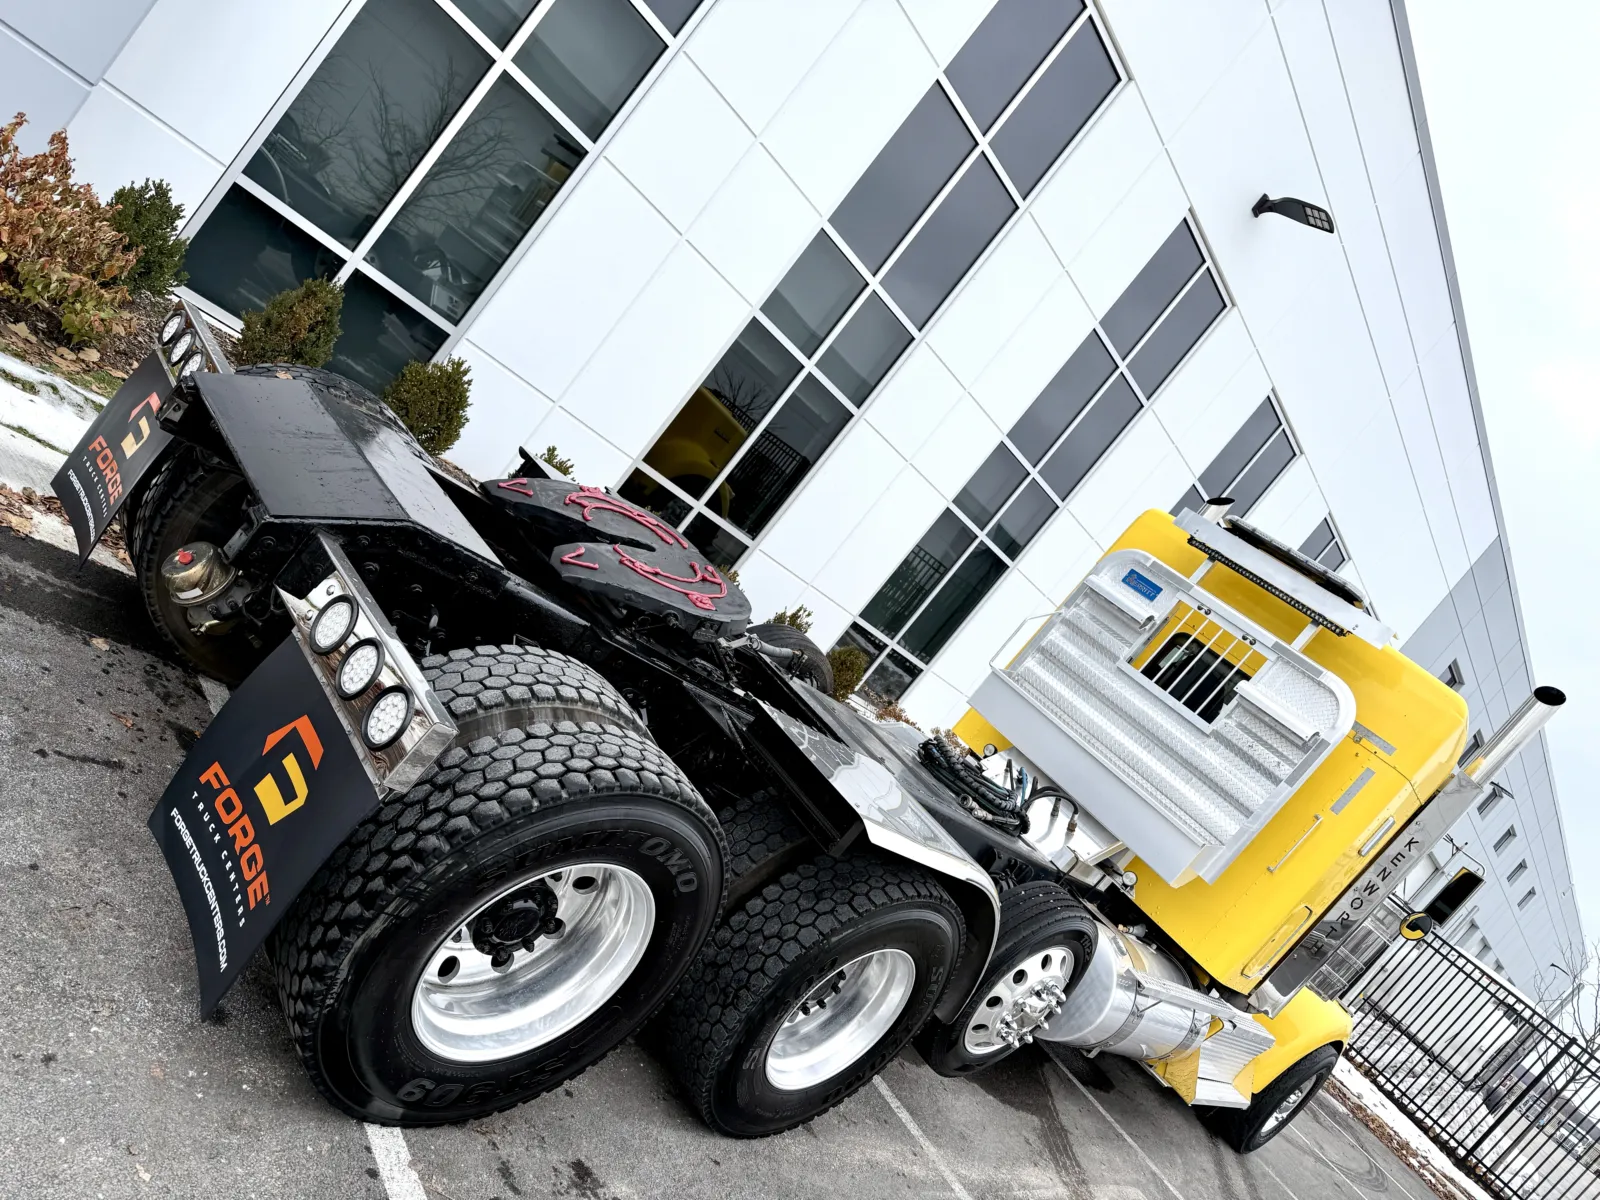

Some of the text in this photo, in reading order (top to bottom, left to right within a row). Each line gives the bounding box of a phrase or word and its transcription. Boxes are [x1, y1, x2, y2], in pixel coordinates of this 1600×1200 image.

[83, 456, 97, 483] TRUCK
[88, 435, 123, 505] FORGE
[170, 808, 227, 973] FORGETRUCKCENTERS.COM
[192, 791, 245, 927] TRUCK CENTERS
[199, 761, 269, 911] FORGE
[1312, 837, 1419, 955] KENWORTH
